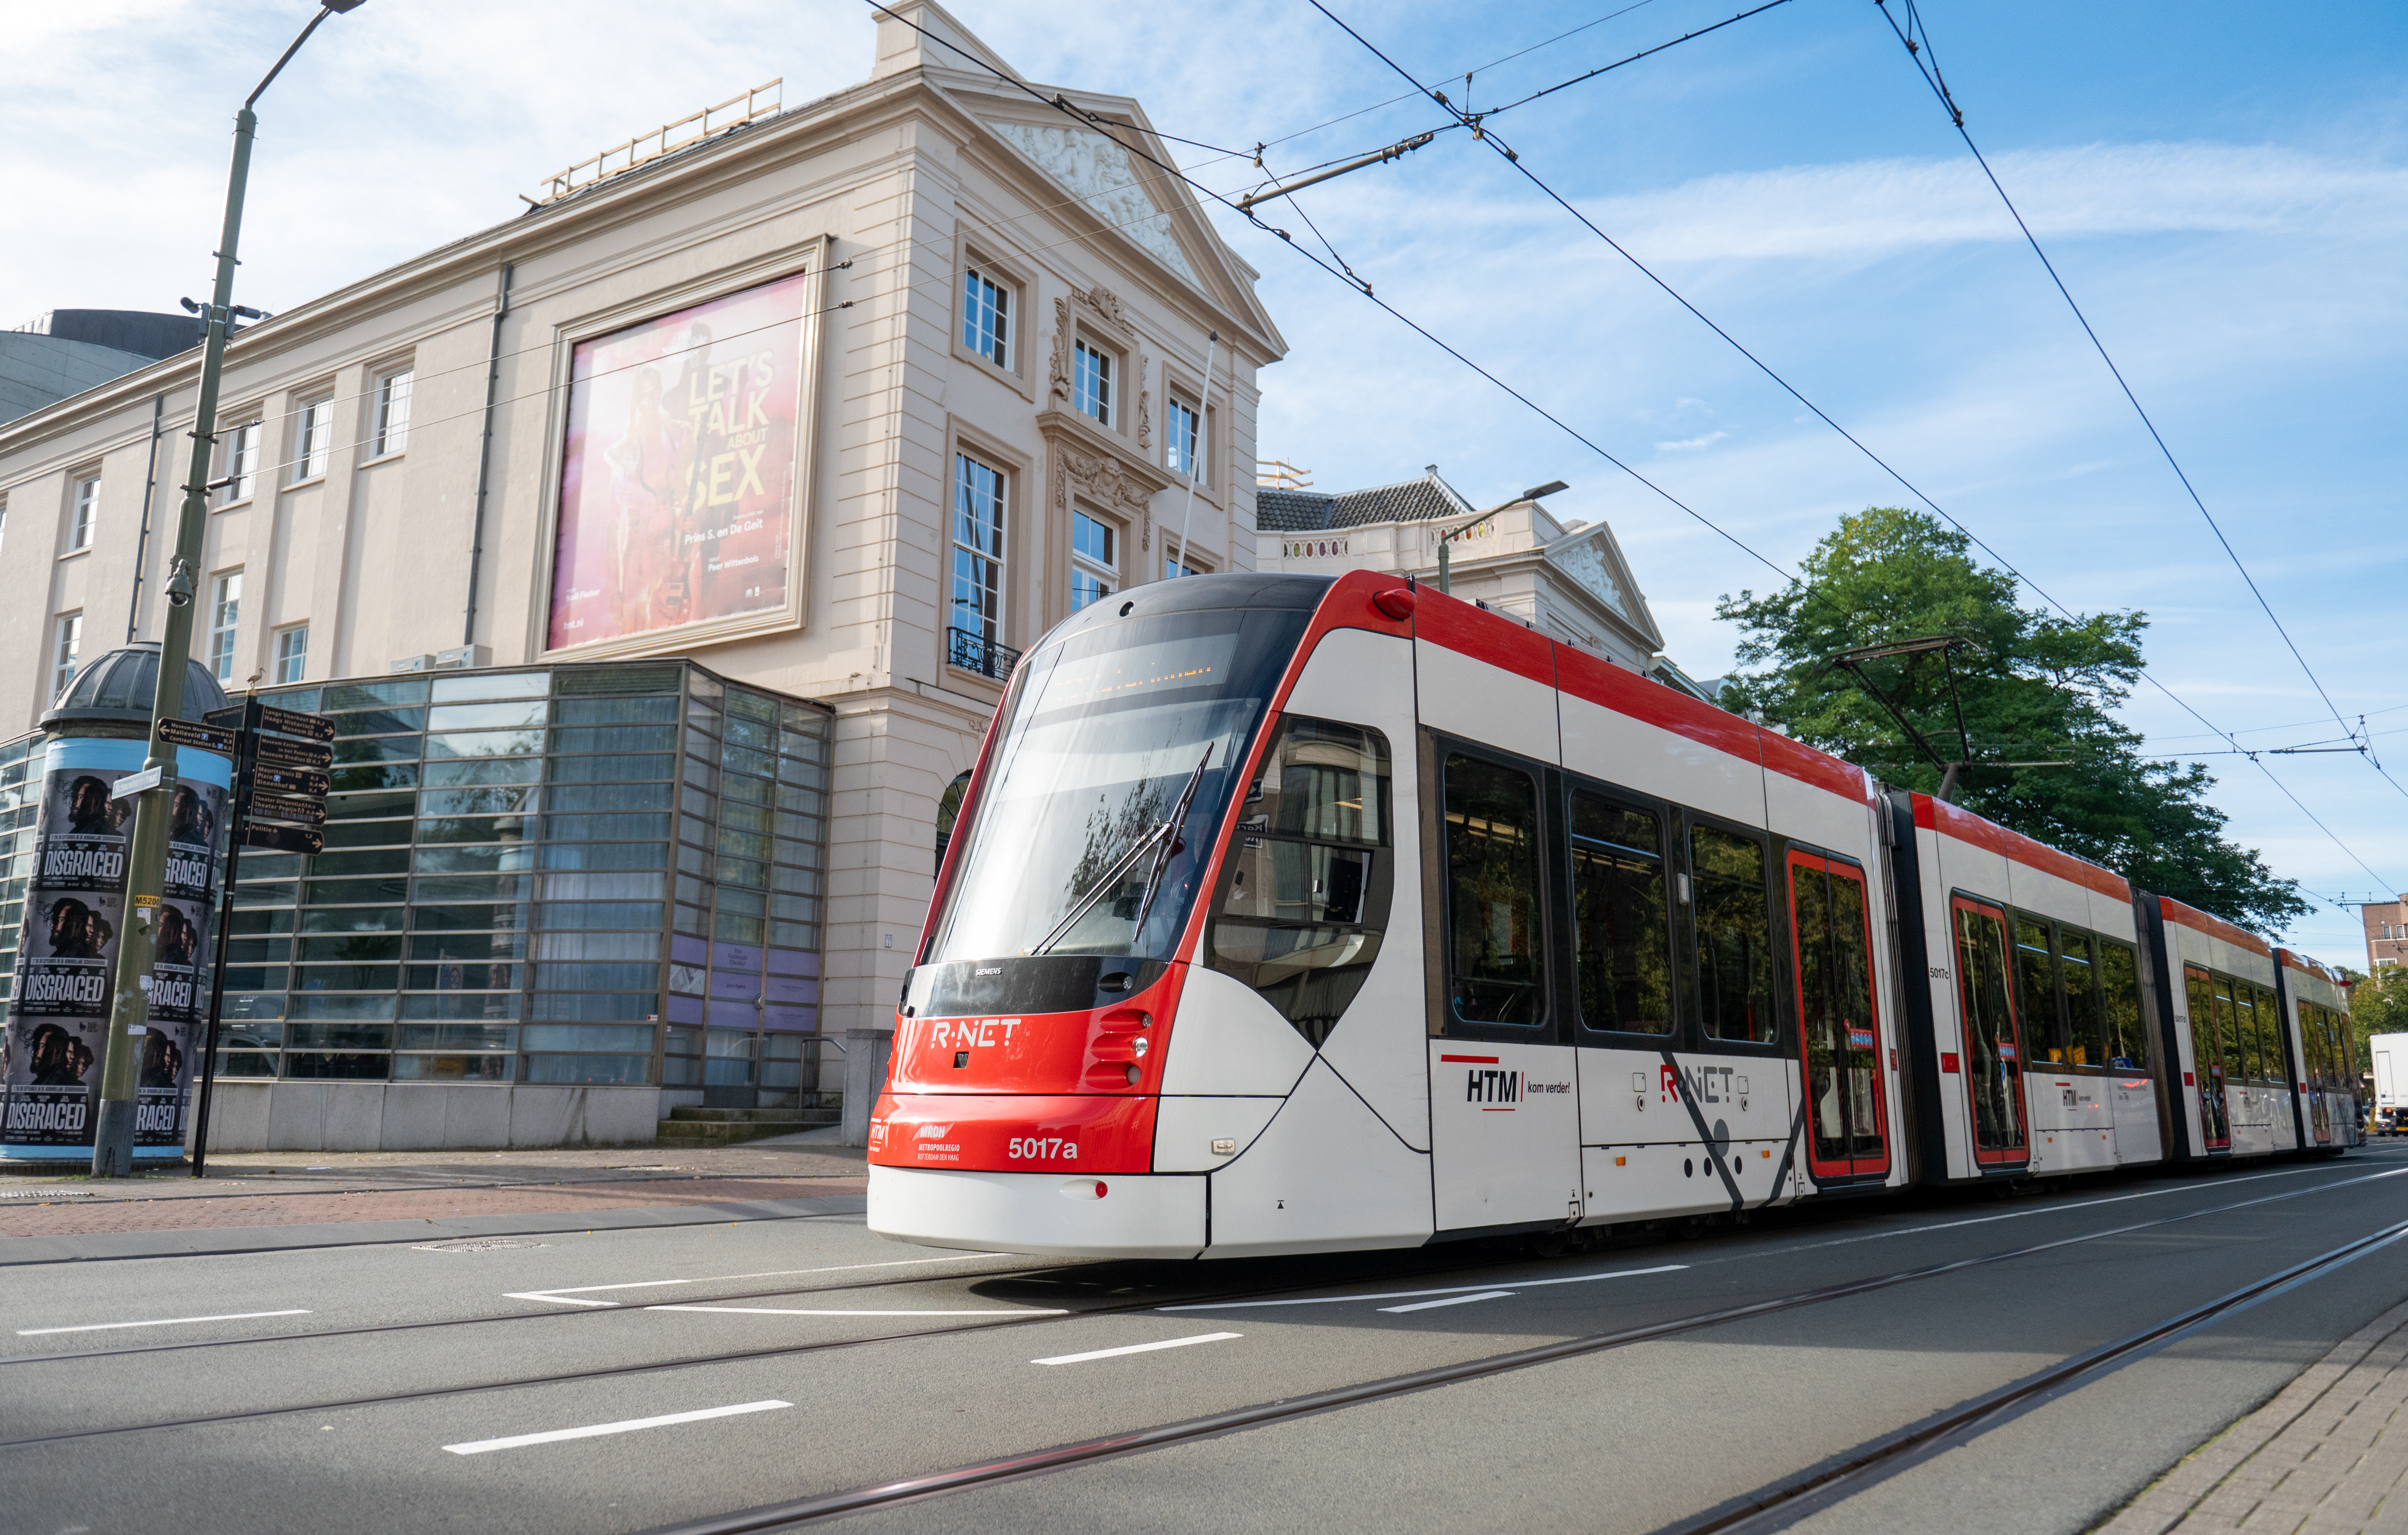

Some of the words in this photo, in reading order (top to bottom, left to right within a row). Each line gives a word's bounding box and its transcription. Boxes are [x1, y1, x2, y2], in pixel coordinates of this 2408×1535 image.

[689, 351, 773, 407] LET'S
[688, 386, 771, 443] TALK
[726, 427, 769, 450] ABOUT
[682, 443, 766, 513] SEX
[684, 532, 706, 545] Prins
[707, 529, 715, 540] S.
[717, 528, 728, 537] en
[730, 524, 742, 534] De
[744, 518, 764, 531] Geit
[708, 563, 723, 572] Peer
[724, 554, 759, 568] Wittenbols
[264, 715, 282, 724] Haags
[284, 719, 315, 730] Historisch
[283, 713, 309, 722] Voorhout
[170, 728, 201, 739] Malieveld
[282, 725, 307, 734] Museum
[262, 738, 282, 746] Museum
[260, 750, 283, 759] Museum
[285, 754, 305, 763] Bredius
[258, 766, 294, 777] Mauritshuis
[257, 779, 288, 789] Binnenhof
[255, 801, 277, 809] Theater
[279, 805, 297, 813] Pepijn
[276, 798, 302, 807] Diligentia
[252, 824, 272, 833] Politie
[44, 851, 123, 877] DISGRACED
[164, 857, 207, 887] GRACED
[135, 896, 160, 906] M5200
[975, 968, 1003, 976] SIEMENS
[1930, 967, 1949, 980] 5017c
[25, 974, 105, 1002] DISGRACED
[150, 980, 192, 1007] RACED
[1467, 1070, 1517, 1102] HTM
[1528, 1081, 1543, 1093] kom
[1546, 1082, 1570, 1094] verder!
[2063, 1089, 2077, 1106] HTM
[6, 1102, 86, 1130] DISGRACED
[136, 1105, 175, 1131] RACED
[871, 1124, 886, 1140] HTM
[920, 1125, 946, 1138] MRDH
[1009, 1137, 1078, 1159] 5017a
